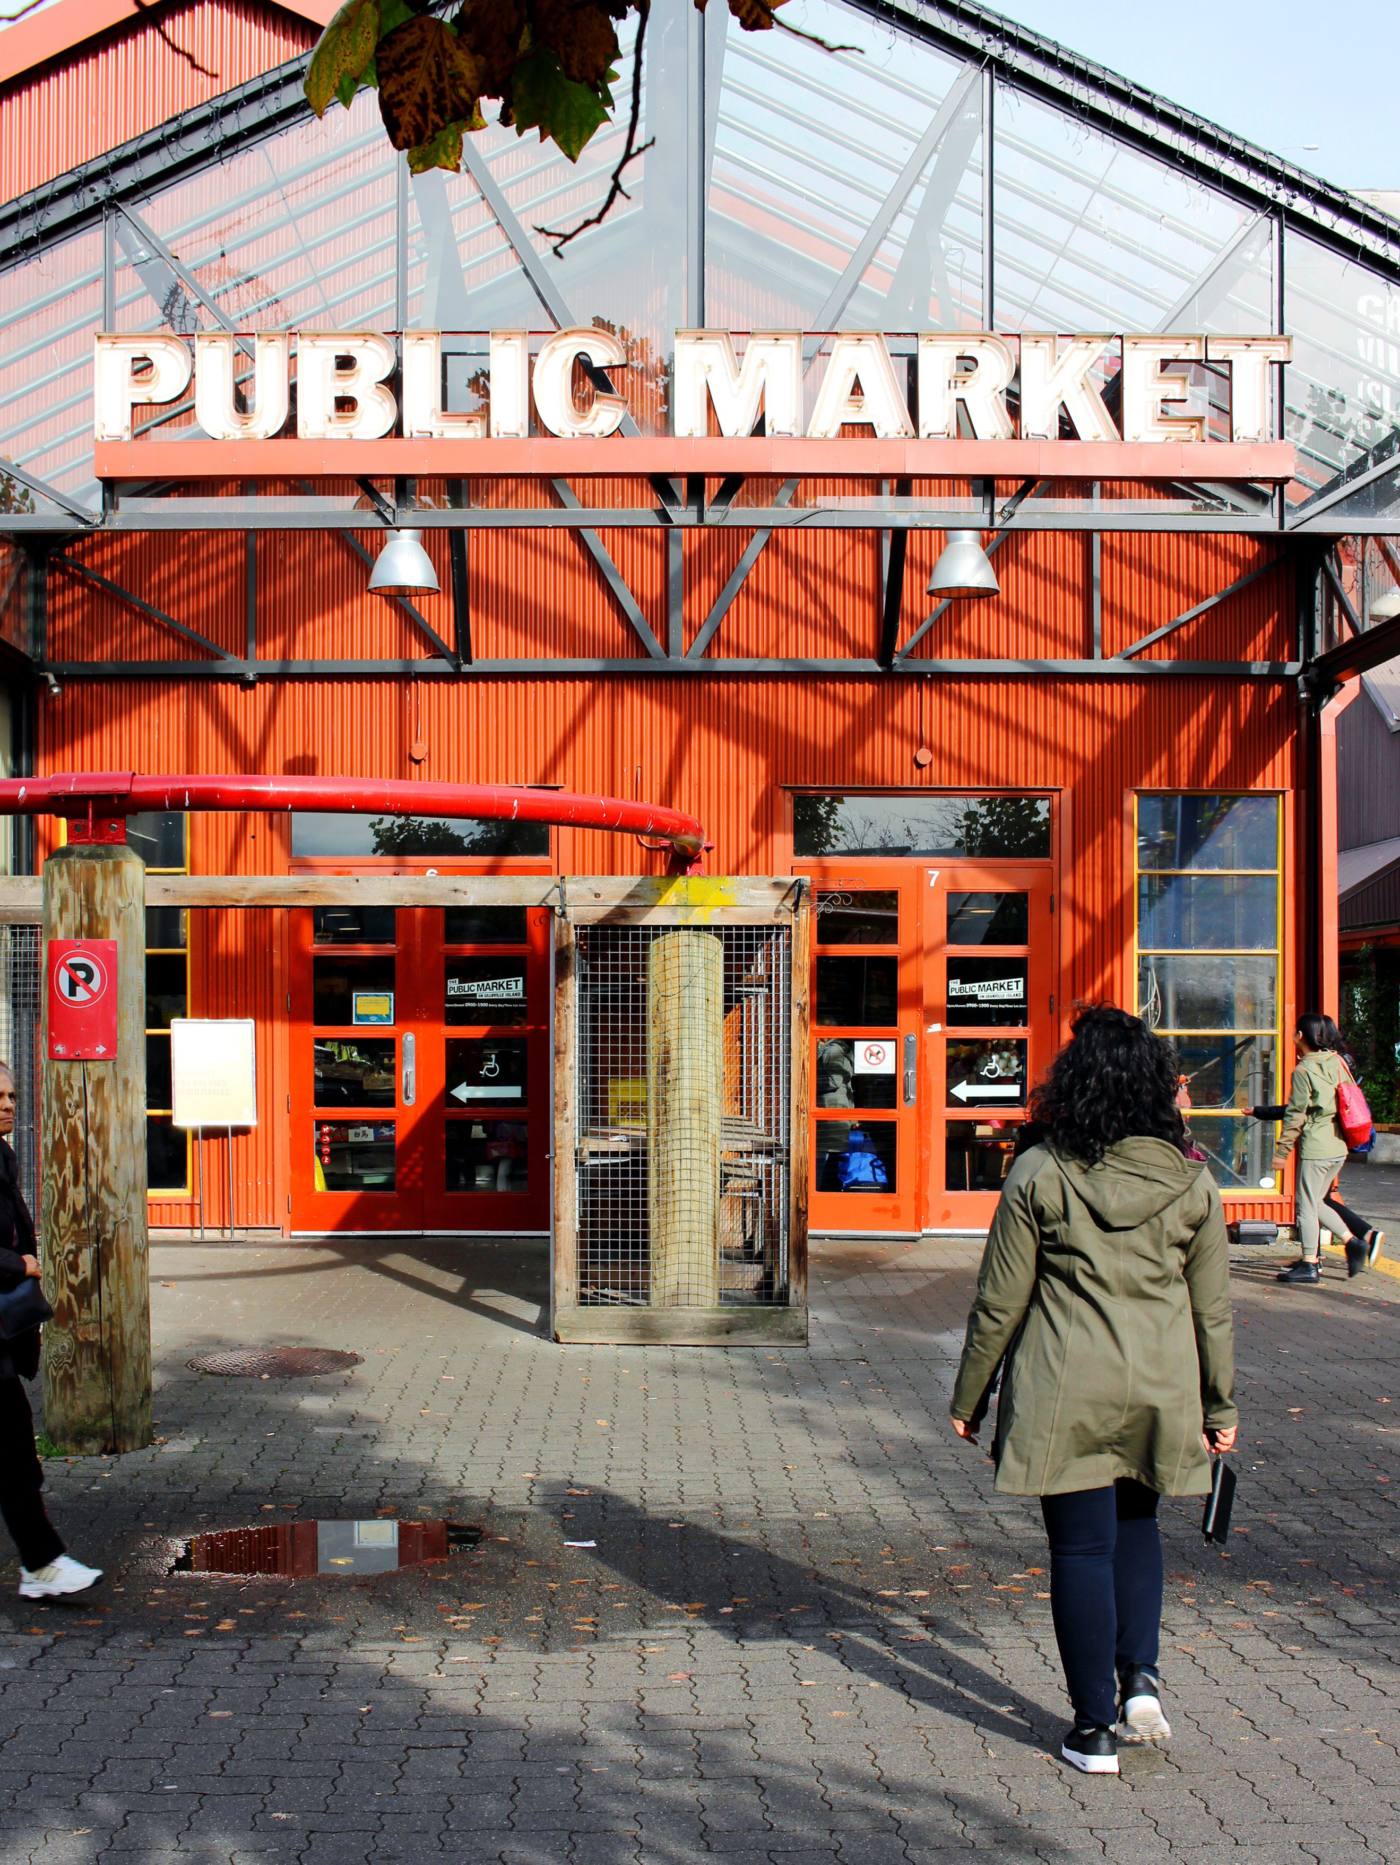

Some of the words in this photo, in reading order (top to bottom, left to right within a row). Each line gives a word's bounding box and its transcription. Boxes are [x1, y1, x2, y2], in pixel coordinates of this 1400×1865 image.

[94, 327, 630, 440] PUBLIC
[674, 328, 1293, 444] MARKET
[927, 870, 940, 887] 7
[449, 985, 476, 993] PUBLIC
[476, 979, 521, 992] MARKET
[950, 985, 977, 994] PUBLIC
[977, 980, 1021, 992] MARKET
